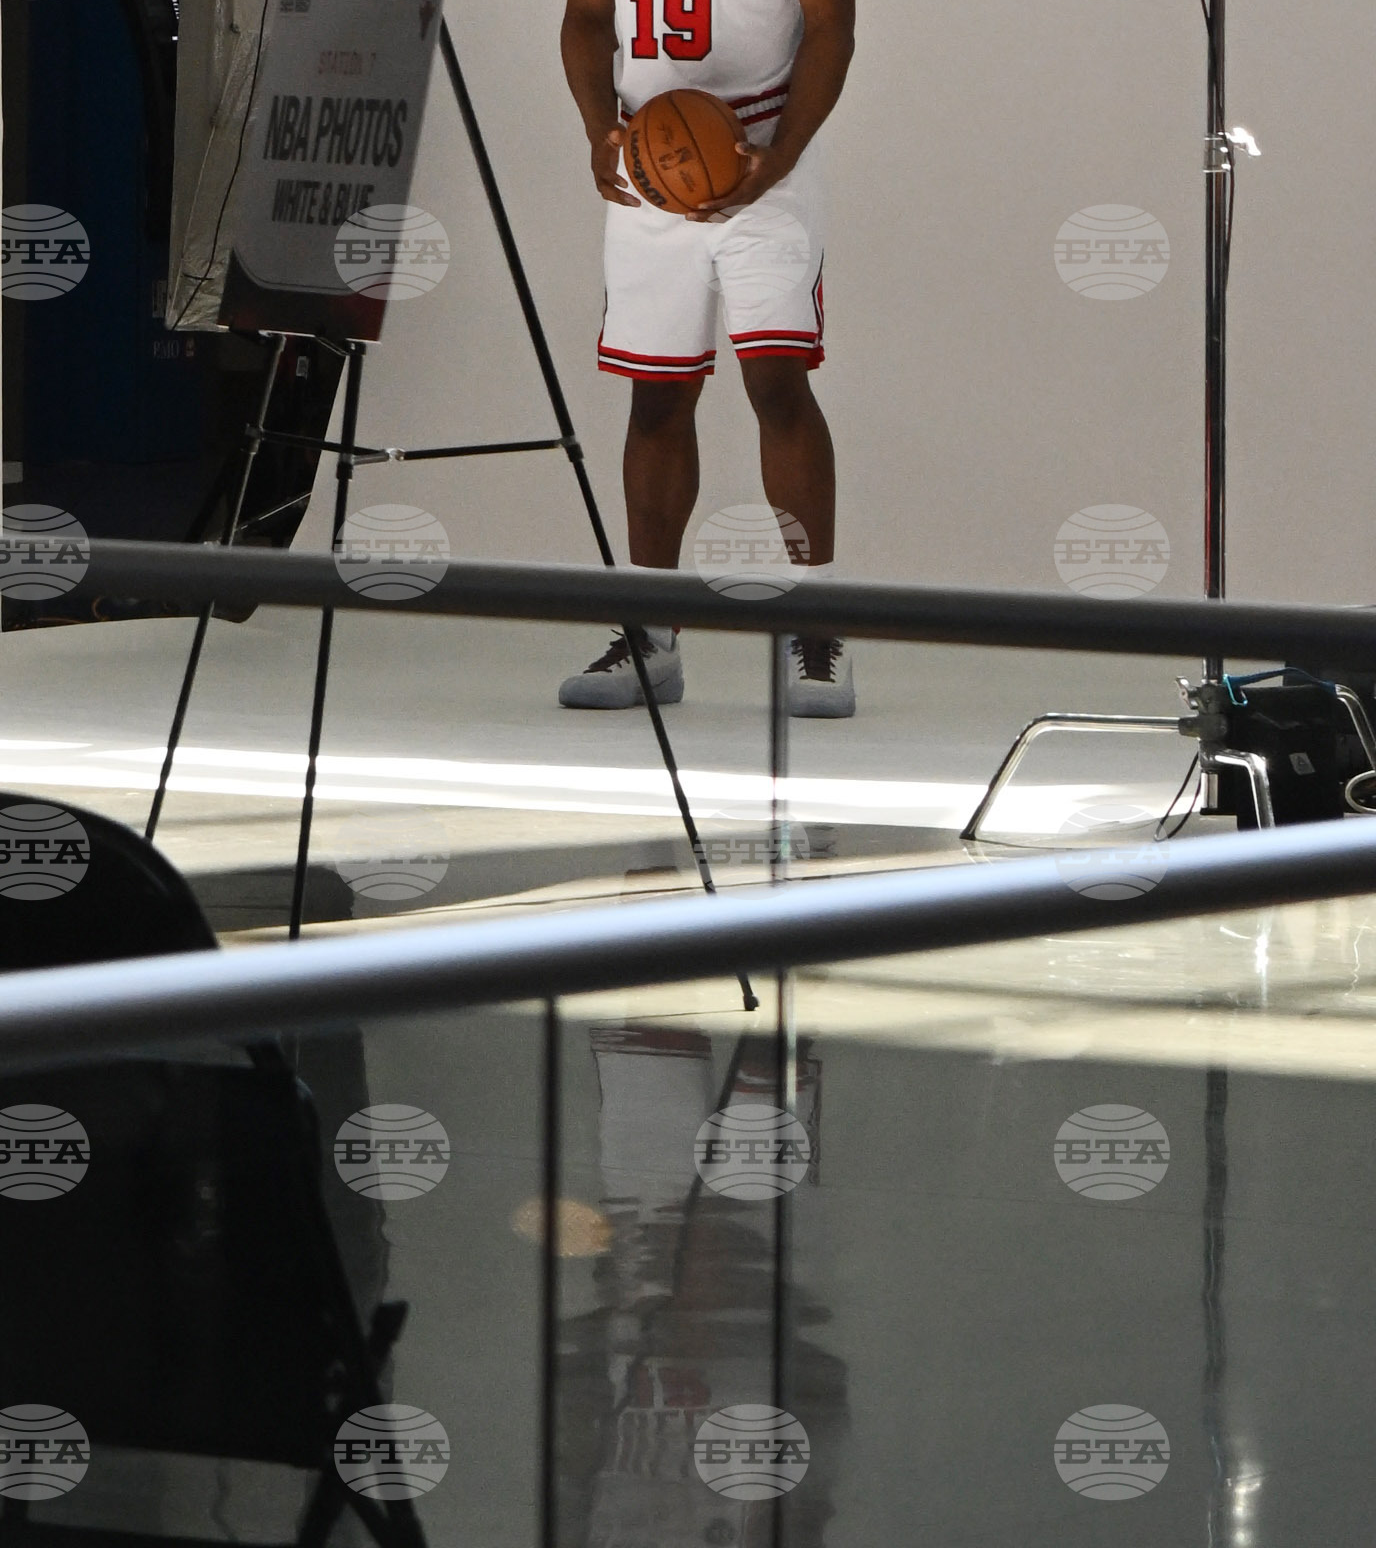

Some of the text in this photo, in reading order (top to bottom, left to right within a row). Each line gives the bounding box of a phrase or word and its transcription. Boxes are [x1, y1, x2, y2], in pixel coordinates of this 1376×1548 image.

[264, 95, 409, 168] NBA PHOTOS
[272, 178, 321, 225] WHITE
